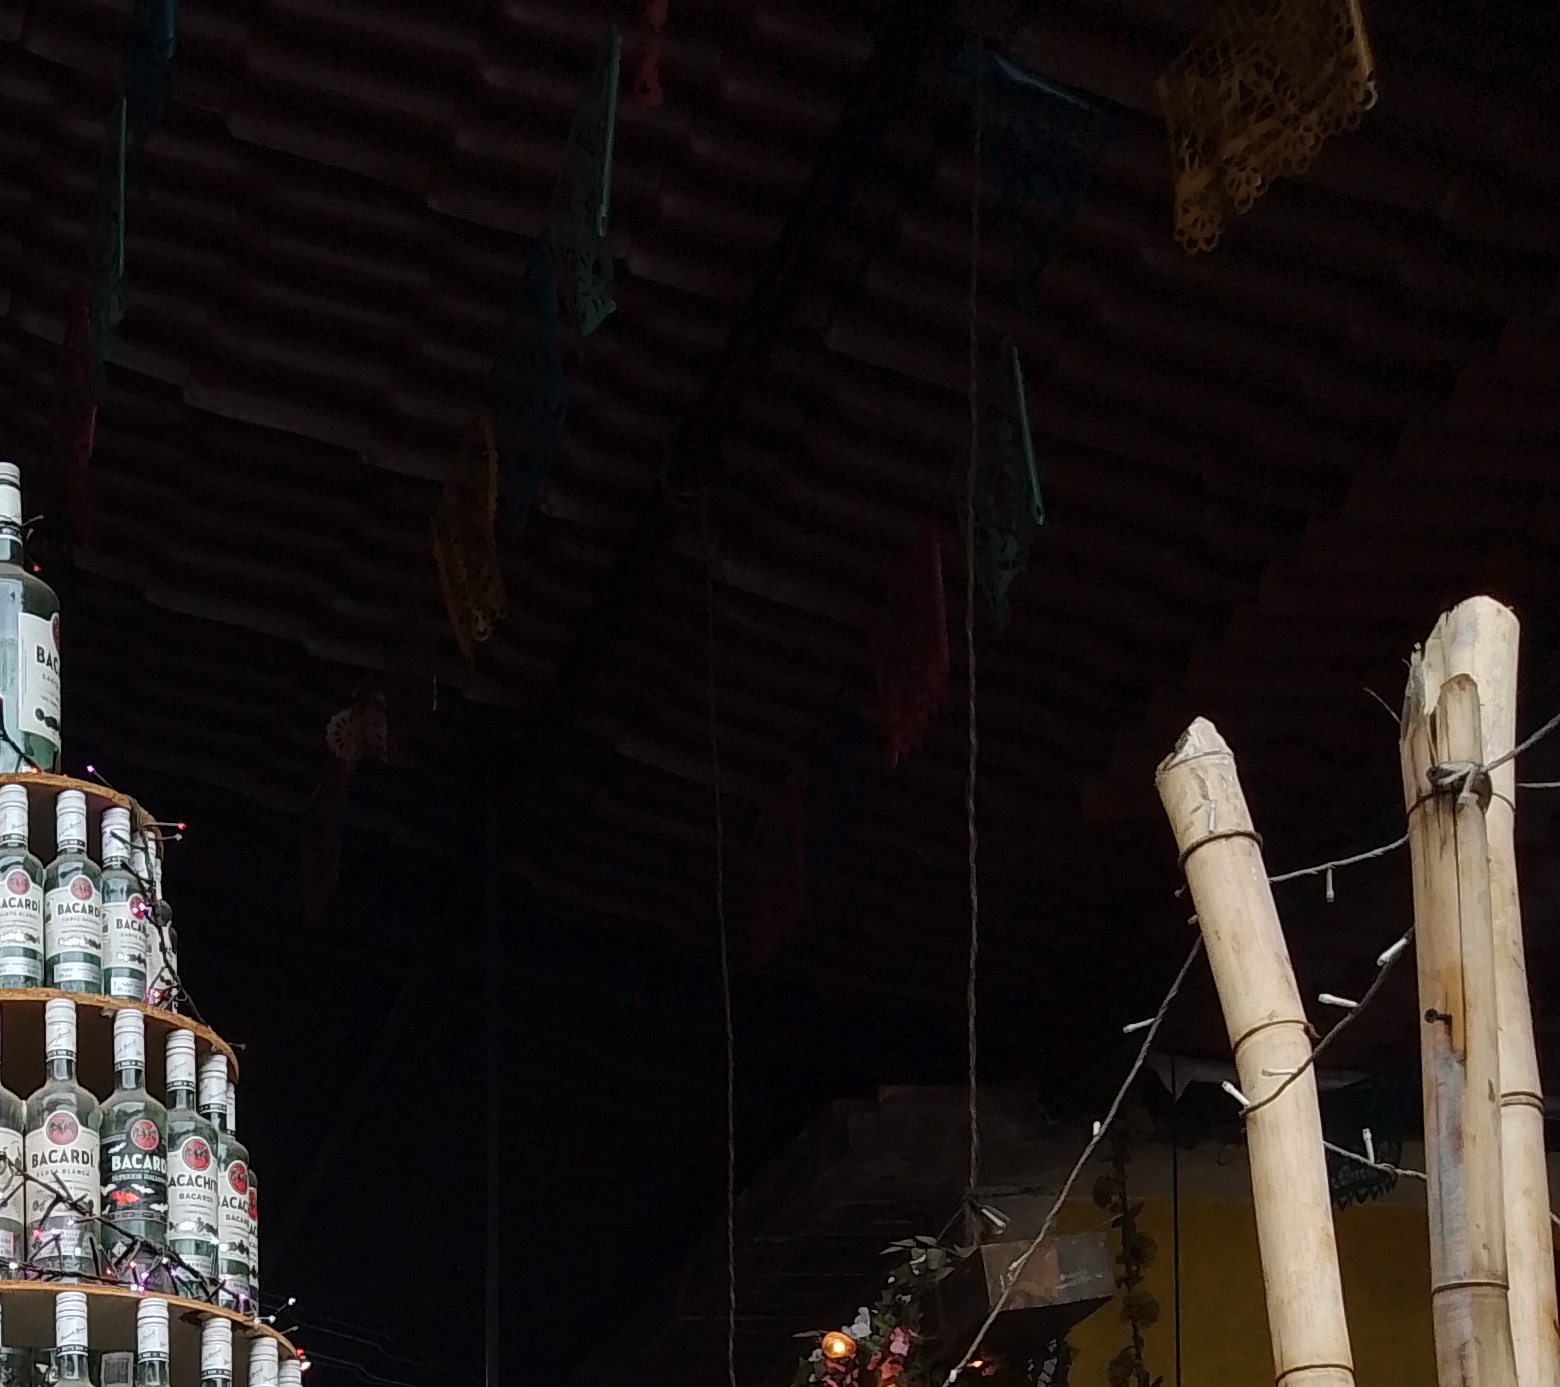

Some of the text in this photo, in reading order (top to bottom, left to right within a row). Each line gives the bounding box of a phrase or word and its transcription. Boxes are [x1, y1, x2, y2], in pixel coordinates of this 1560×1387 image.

[57, 902, 101, 918] BACARD
[32, 1148, 95, 1168] BACARDÍ
[111, 1154, 167, 1174] BACARD
